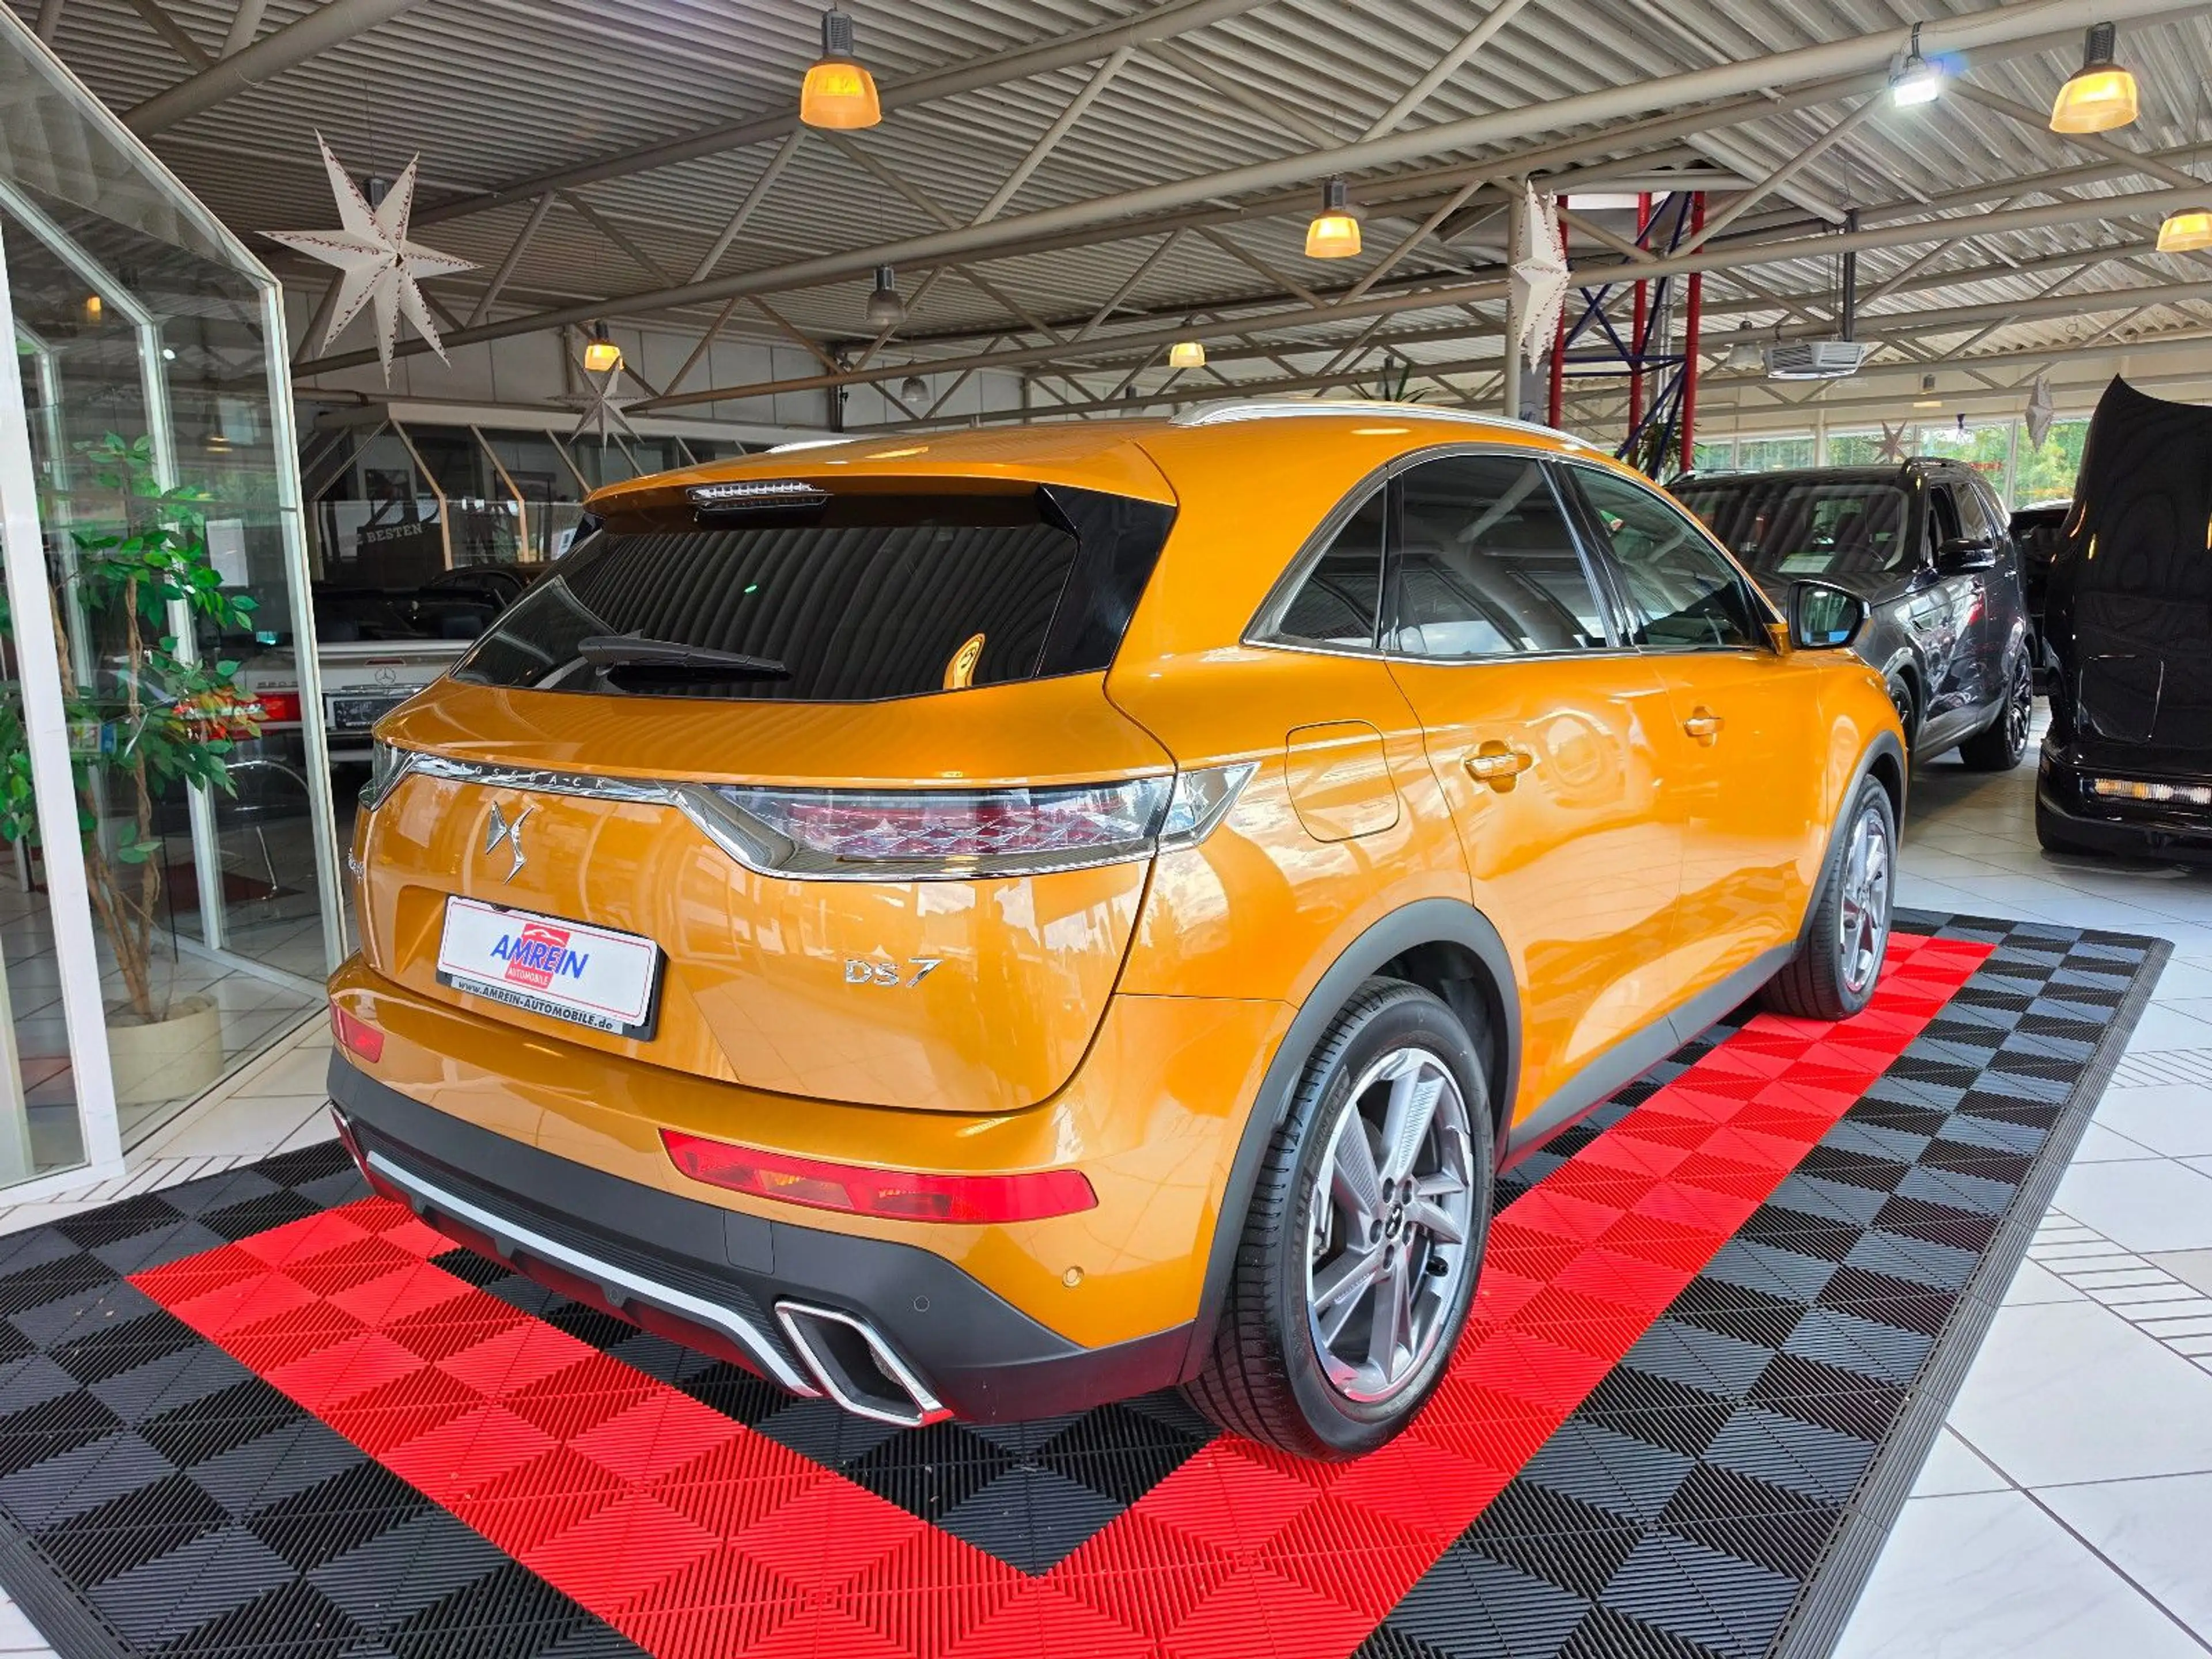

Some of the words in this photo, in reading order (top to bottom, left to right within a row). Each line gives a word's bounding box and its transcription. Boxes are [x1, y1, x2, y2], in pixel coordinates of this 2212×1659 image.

[366, 524, 423, 543] BESTEN
[490, 934, 590, 979] AMREIN
[507, 967, 548, 986] AUTOMOBILE
[845, 959, 900, 986] DS
[906, 957, 944, 988] 7
